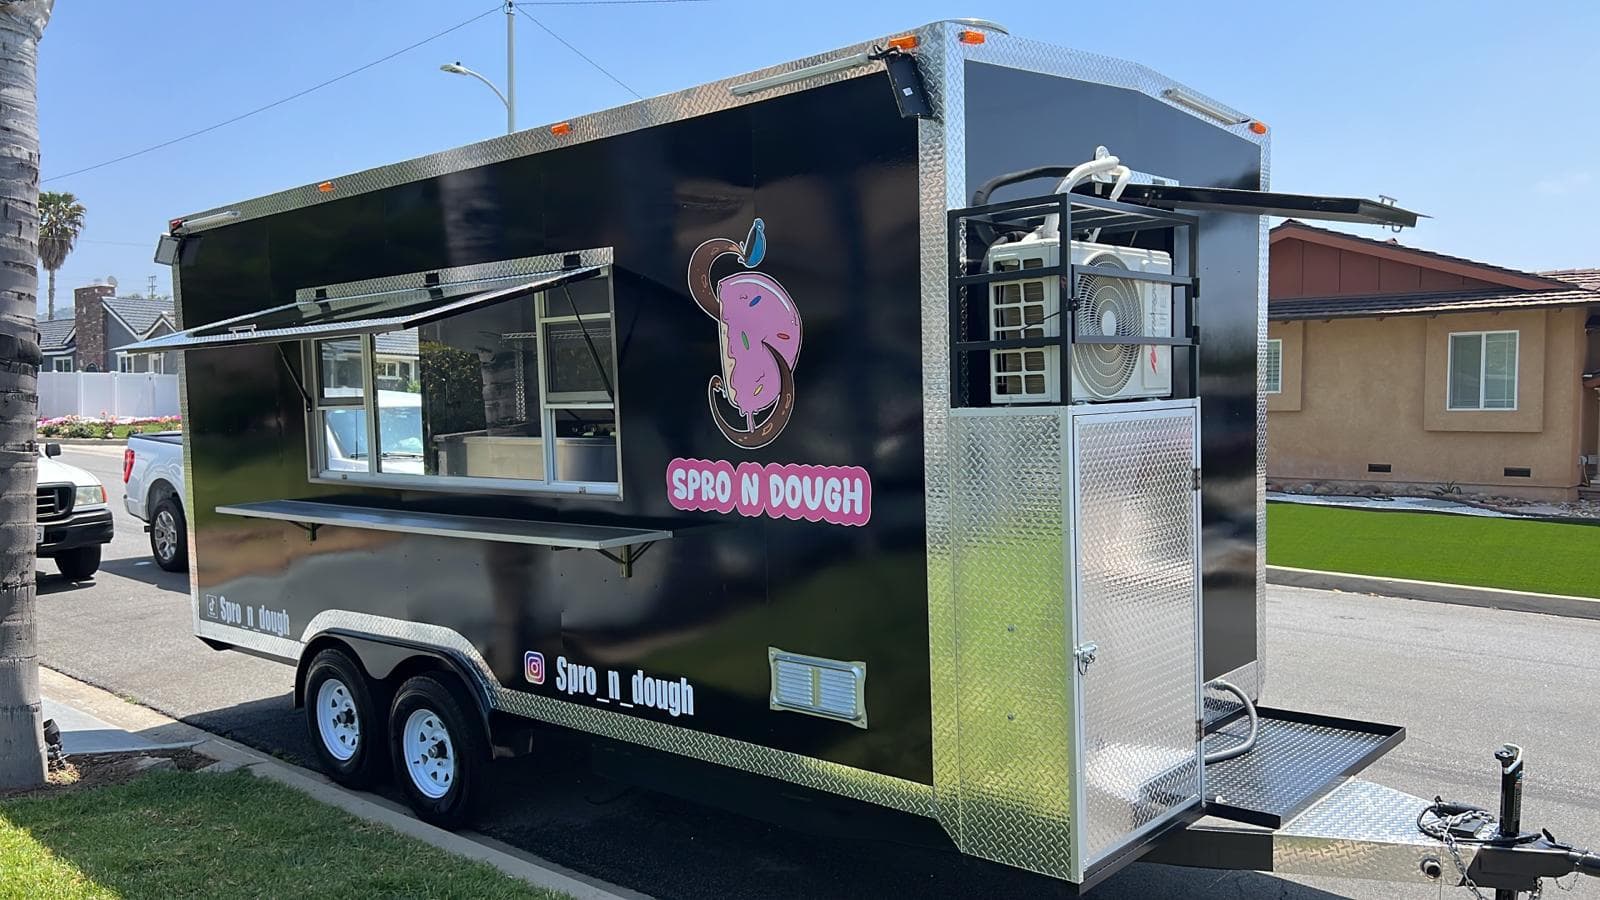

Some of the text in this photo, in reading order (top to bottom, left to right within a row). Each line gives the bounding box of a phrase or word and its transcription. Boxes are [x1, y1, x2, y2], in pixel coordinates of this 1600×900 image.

[672, 468, 863, 515] SPRO N DOUGH
[219, 595, 290, 637] Spro_n_dough
[555, 655, 695, 717] Spro_n_dough
